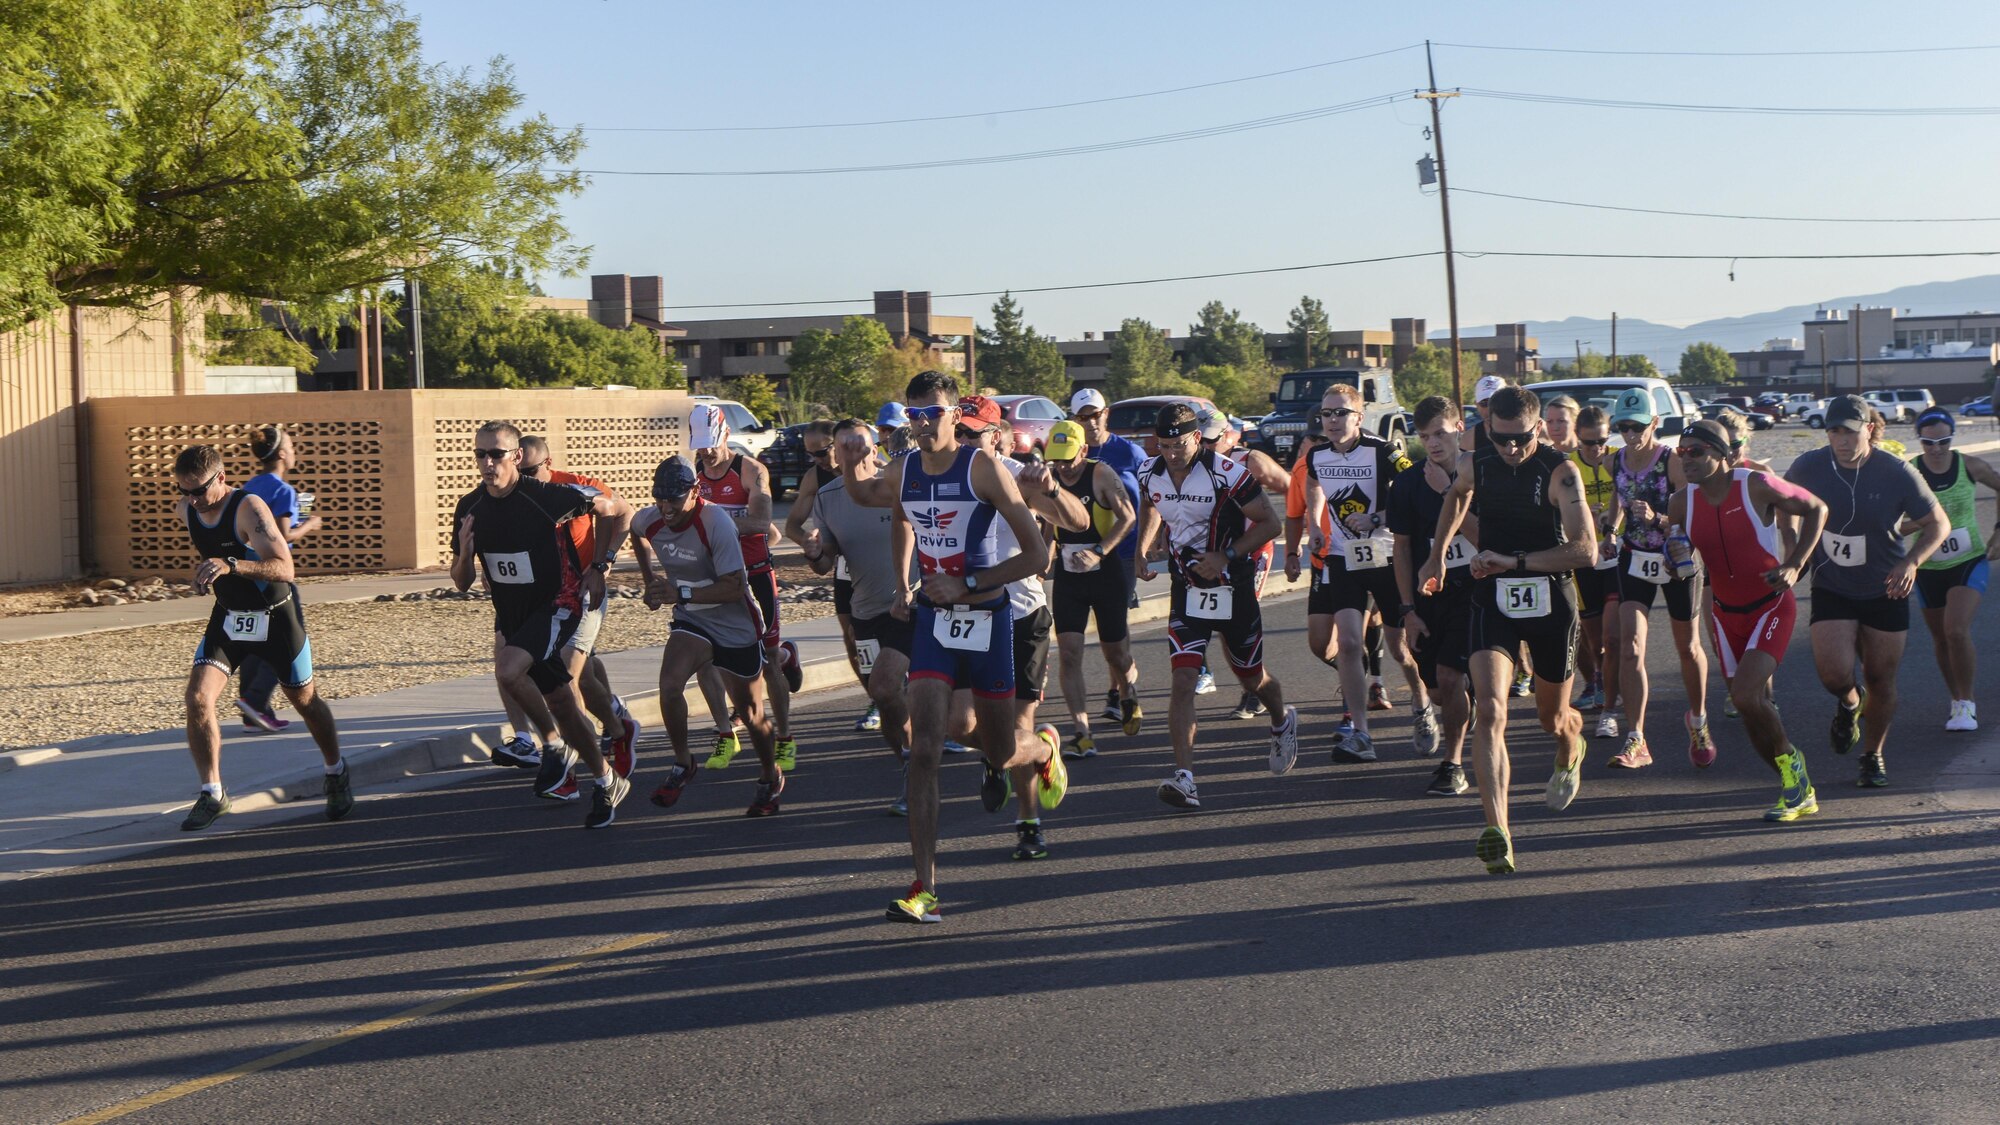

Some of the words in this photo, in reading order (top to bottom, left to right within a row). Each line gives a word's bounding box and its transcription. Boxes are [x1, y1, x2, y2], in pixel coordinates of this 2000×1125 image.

[1320, 467, 1372, 477] COLORADO
[920, 535, 958, 547] RWB
[1832, 540, 1851, 559] 74
[1941, 537, 1959, 553] 80
[1354, 545, 1373, 562] 53
[1446, 543, 1464, 560] 81
[497, 560, 518, 577] 68
[1641, 559, 1659, 577] 49
[1199, 592, 1218, 611] 75
[1510, 587, 1534, 608] 54
[235, 617, 255, 633] 59
[949, 619, 975, 639] 67
